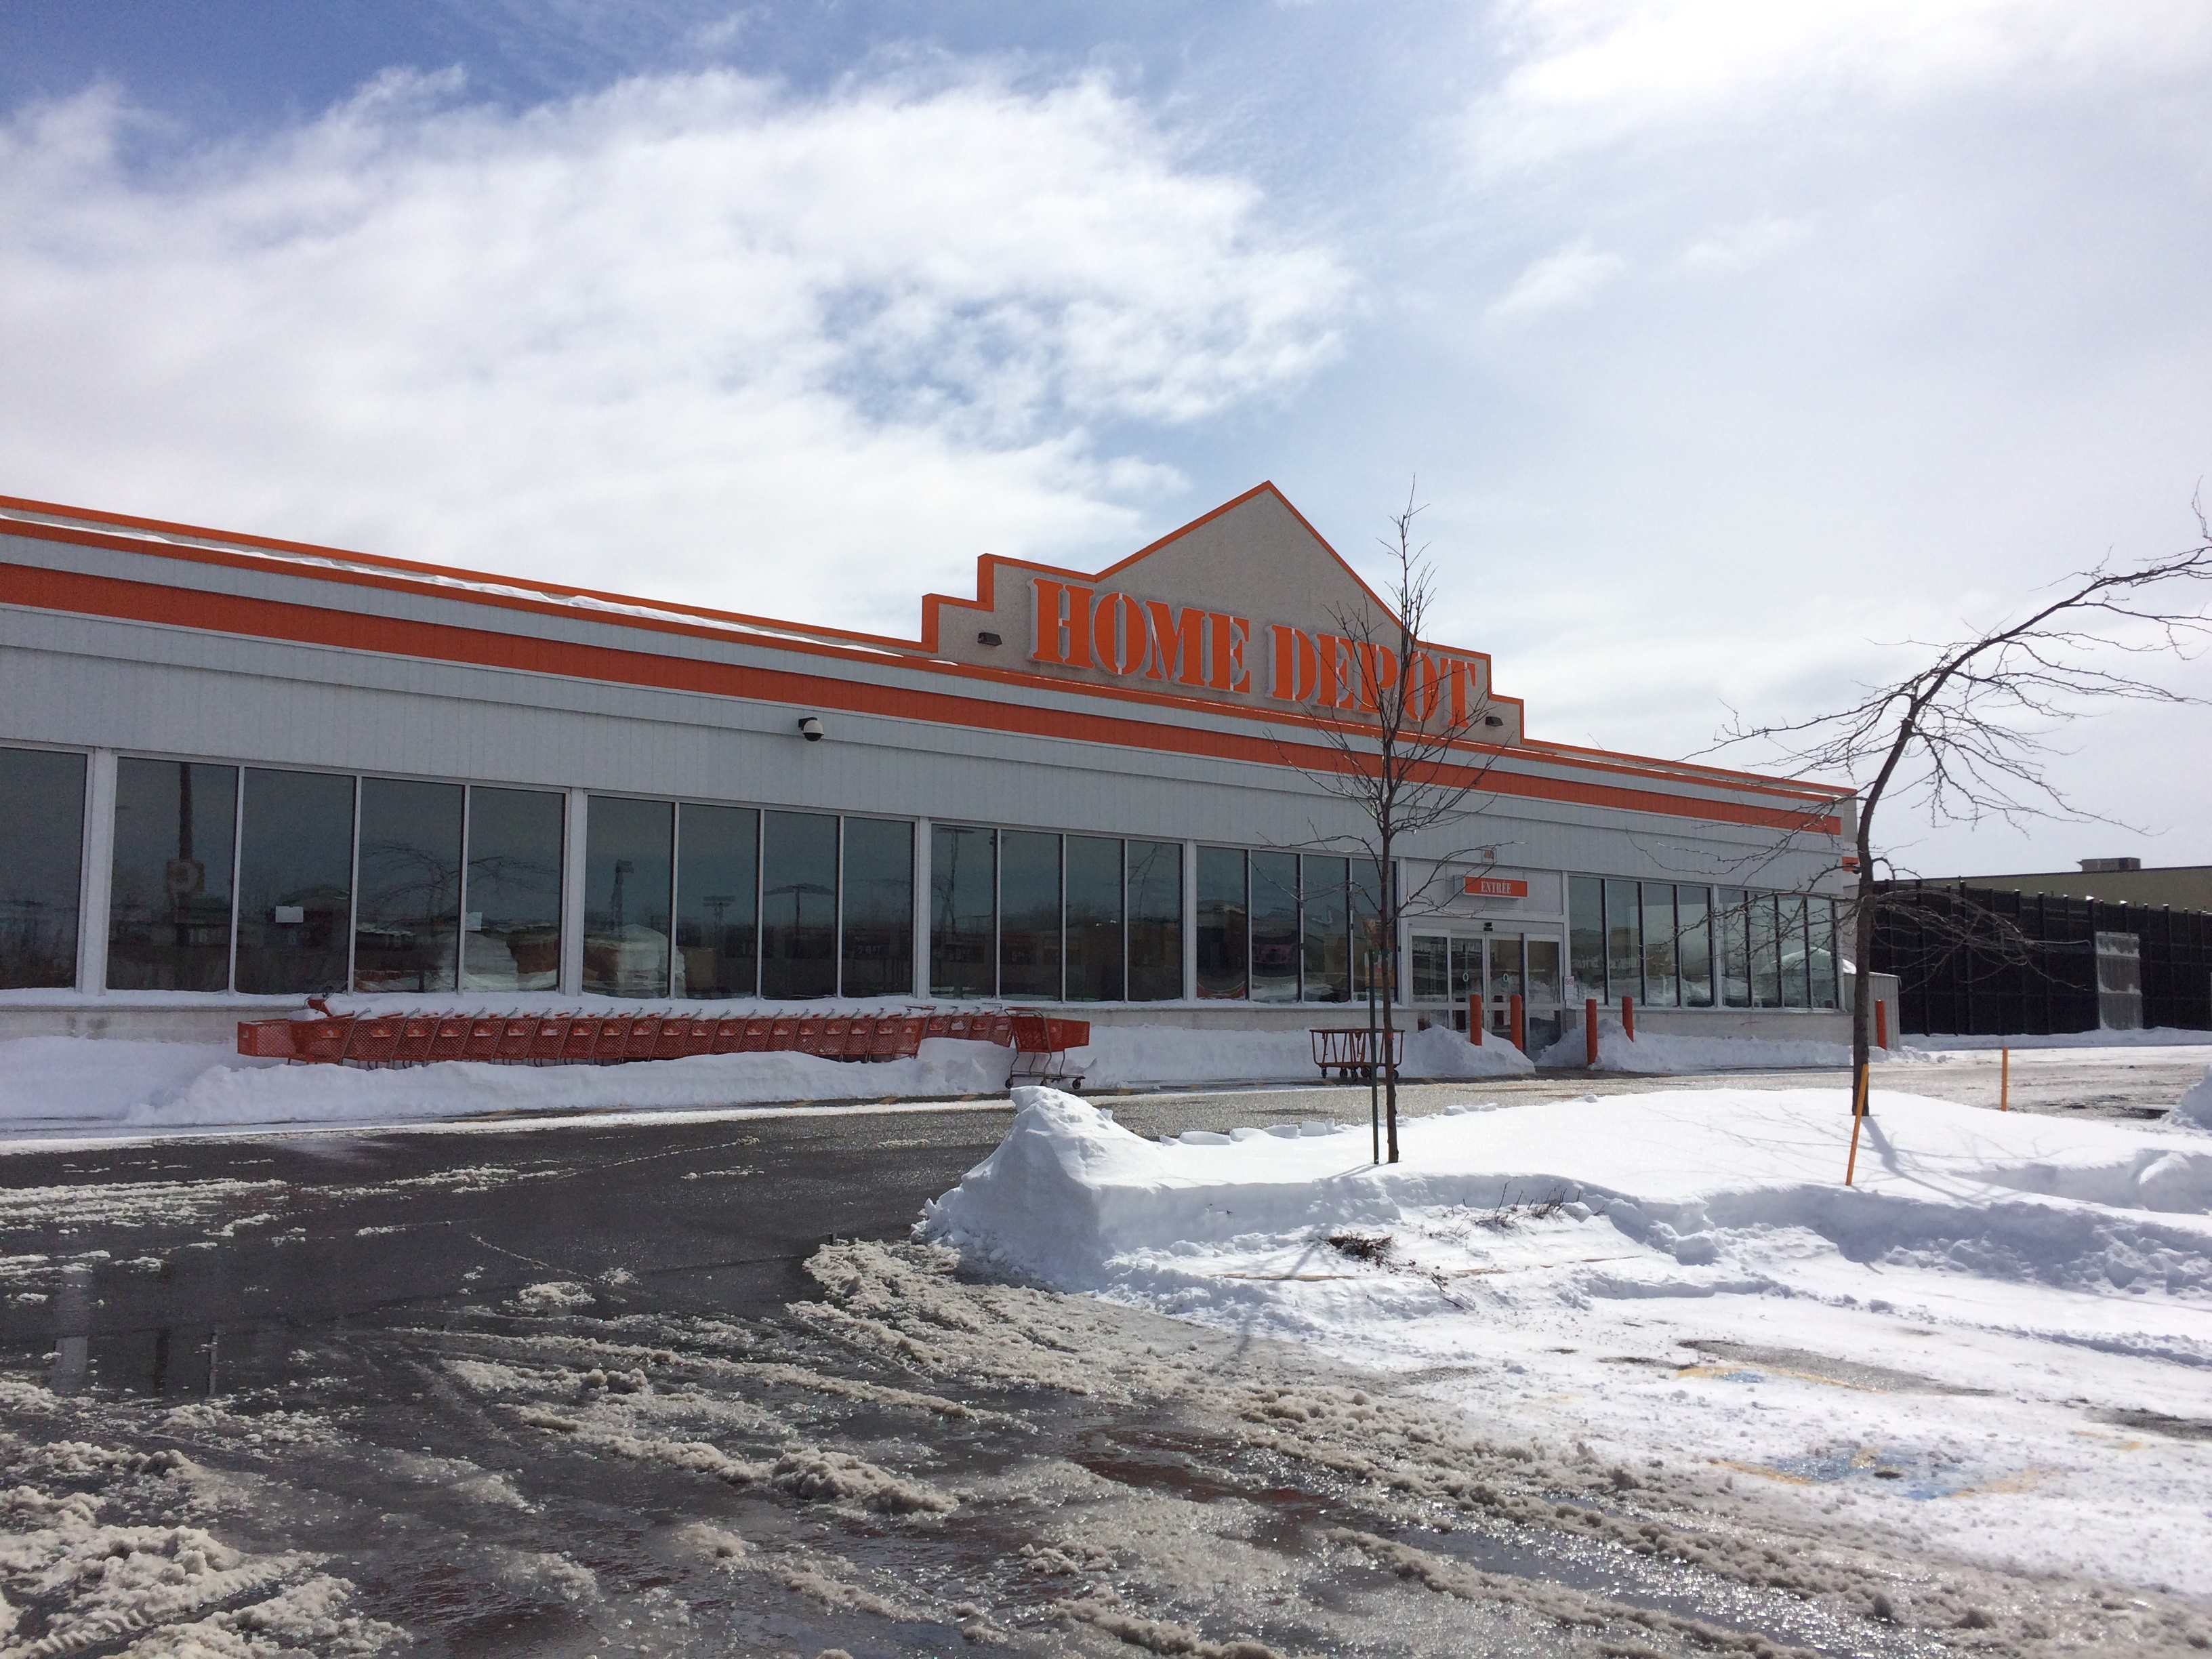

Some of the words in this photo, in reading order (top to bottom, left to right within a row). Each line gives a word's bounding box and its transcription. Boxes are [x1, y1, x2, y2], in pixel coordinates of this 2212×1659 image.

[1031, 577, 1250, 693] HOME
[1270, 624, 1476, 729] DEPOT
[1481, 880, 1511, 895] ENTRÉE
